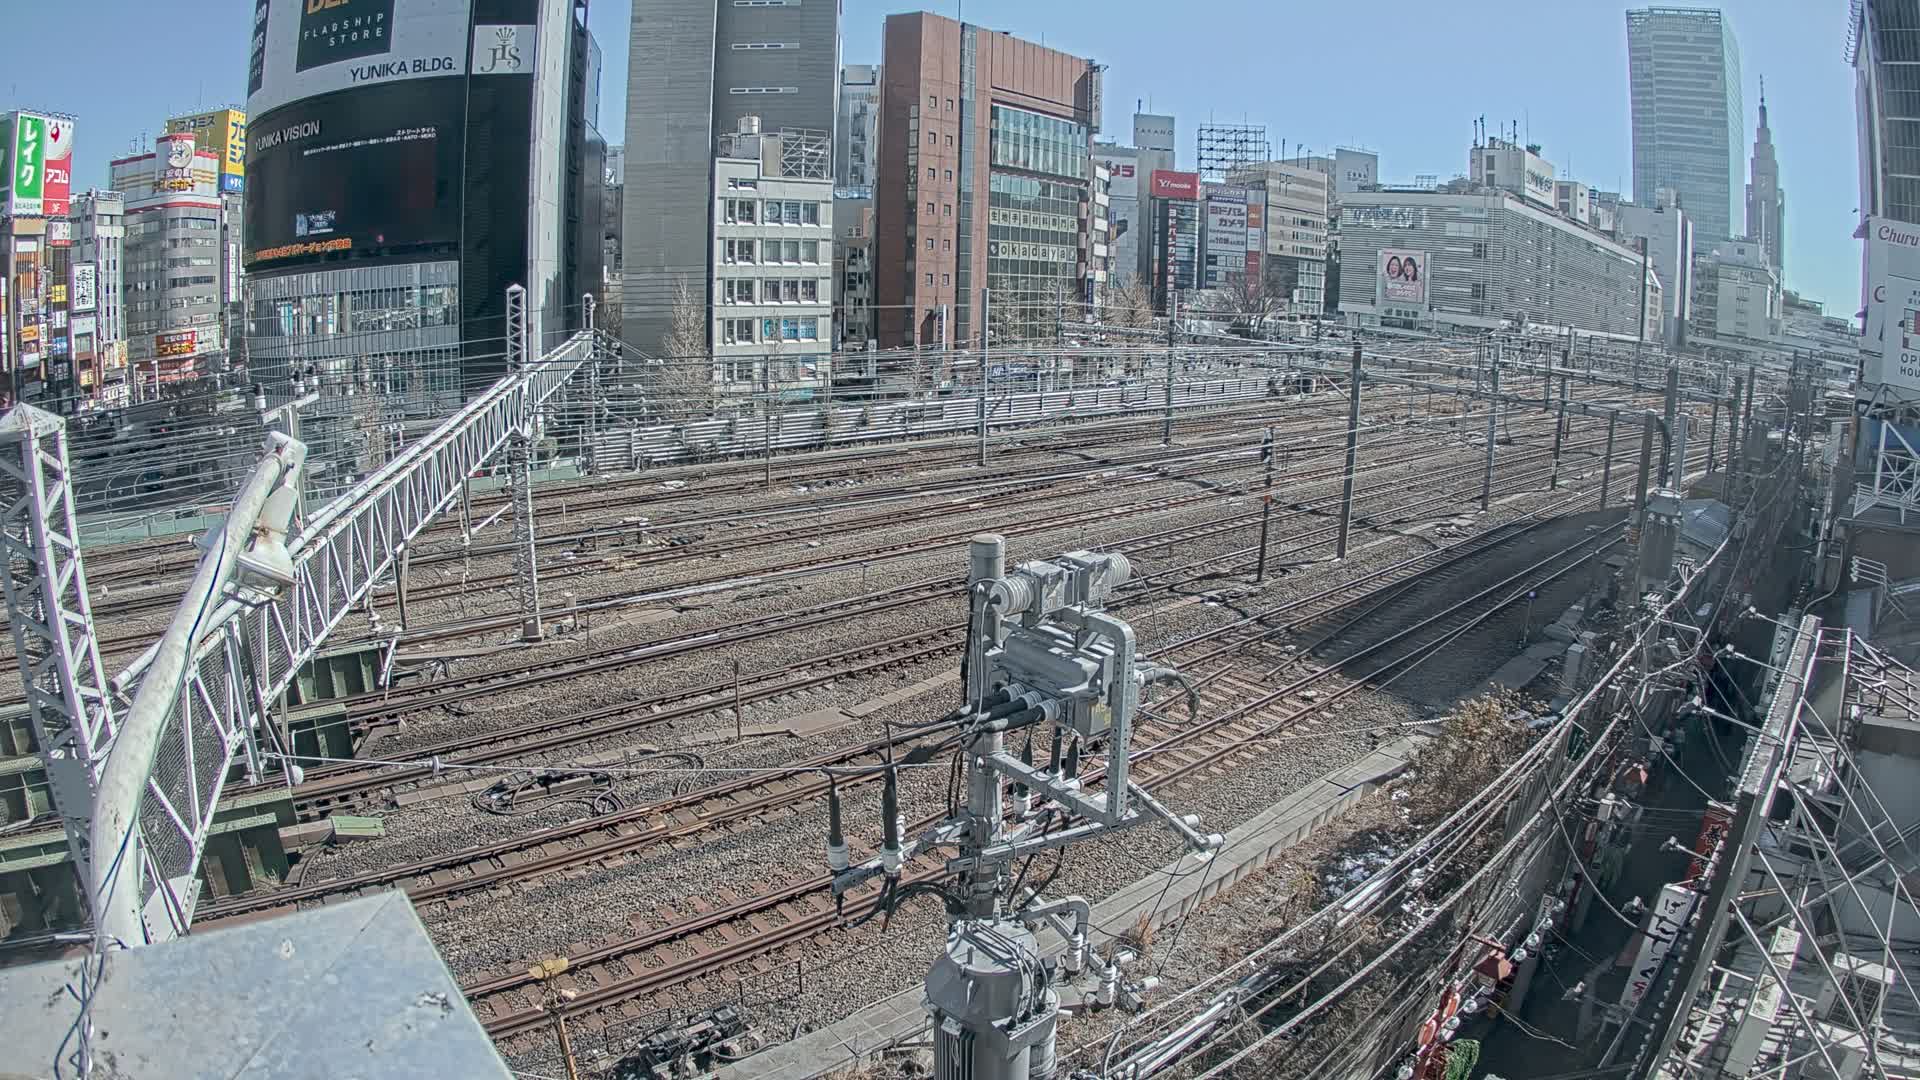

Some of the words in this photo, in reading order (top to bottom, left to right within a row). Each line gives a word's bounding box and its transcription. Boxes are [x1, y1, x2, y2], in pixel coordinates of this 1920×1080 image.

[304, 13, 384, 41] FLAGSHIP
[329, 27, 383, 47] STORE
[350, 59, 408, 83] YUNIKA
[412, 57, 457, 74] BLDG.
[282, 119, 320, 142] VISION
[21, 119, 38, 187] レイク
[46, 168, 69, 185] アコム
[1001, 245, 1067, 260] okadaya
[1900, 353, 1920, 368] OP
